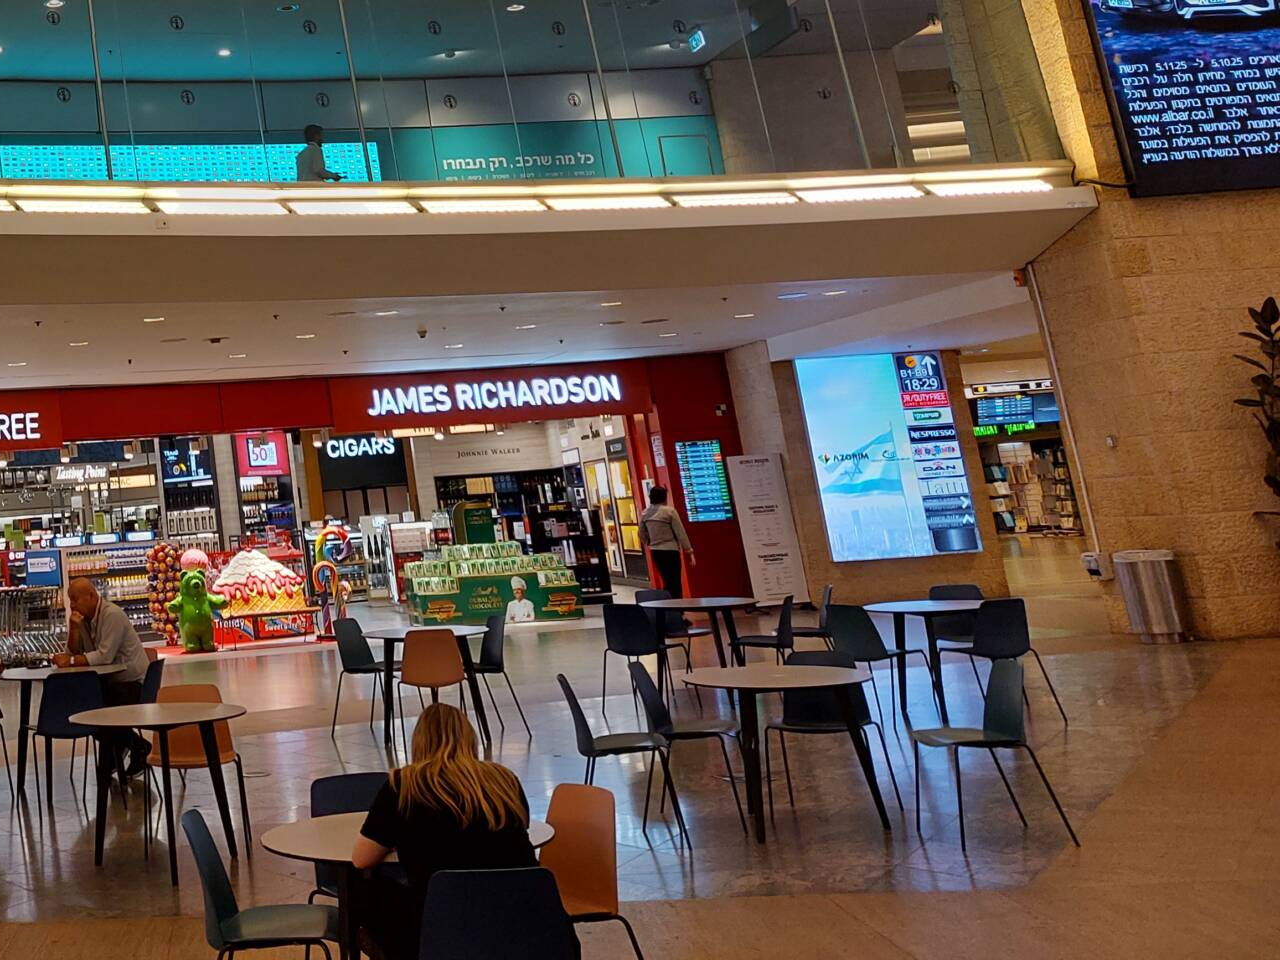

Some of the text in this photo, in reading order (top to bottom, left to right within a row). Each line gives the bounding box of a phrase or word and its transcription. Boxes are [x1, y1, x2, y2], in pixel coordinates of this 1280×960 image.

[1131, 107, 1214, 124] www.albar.co.il
[443, 157, 486, 170] תבחרו
[489, 157, 507, 171] רק
[556, 154, 575, 165] מה
[577, 152, 594, 164] כל
[900, 368, 928, 378] B1-B9
[904, 378, 938, 391] 18:29
[368, 374, 622, 417] JAMES RICHARDSON
[910, 429, 955, 439] NESPRESSO
[327, 436, 396, 458] CIGARS
[457, 450, 489, 458] JOHNNIE
[833, 452, 869, 462] AZORIM
[56, 464, 108, 483] Tasting Point
[922, 464, 956, 472] DAN
